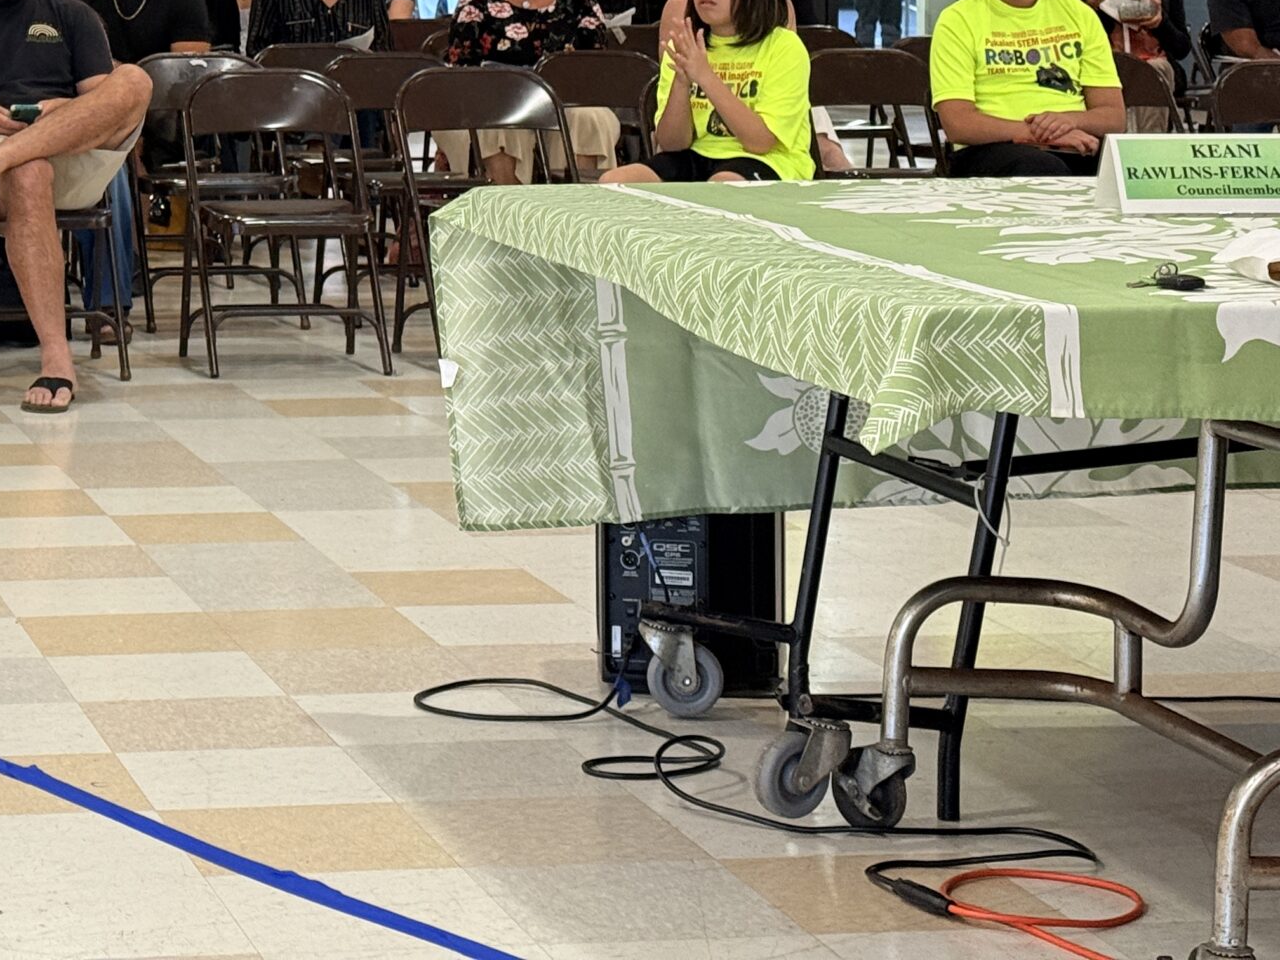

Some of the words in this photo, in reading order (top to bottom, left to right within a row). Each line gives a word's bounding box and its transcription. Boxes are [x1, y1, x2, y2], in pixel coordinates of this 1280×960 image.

[1017, 37, 1040, 48] STEM
[1190, 143, 1262, 159] KEANI
[653, 543, 691, 553] QSC
